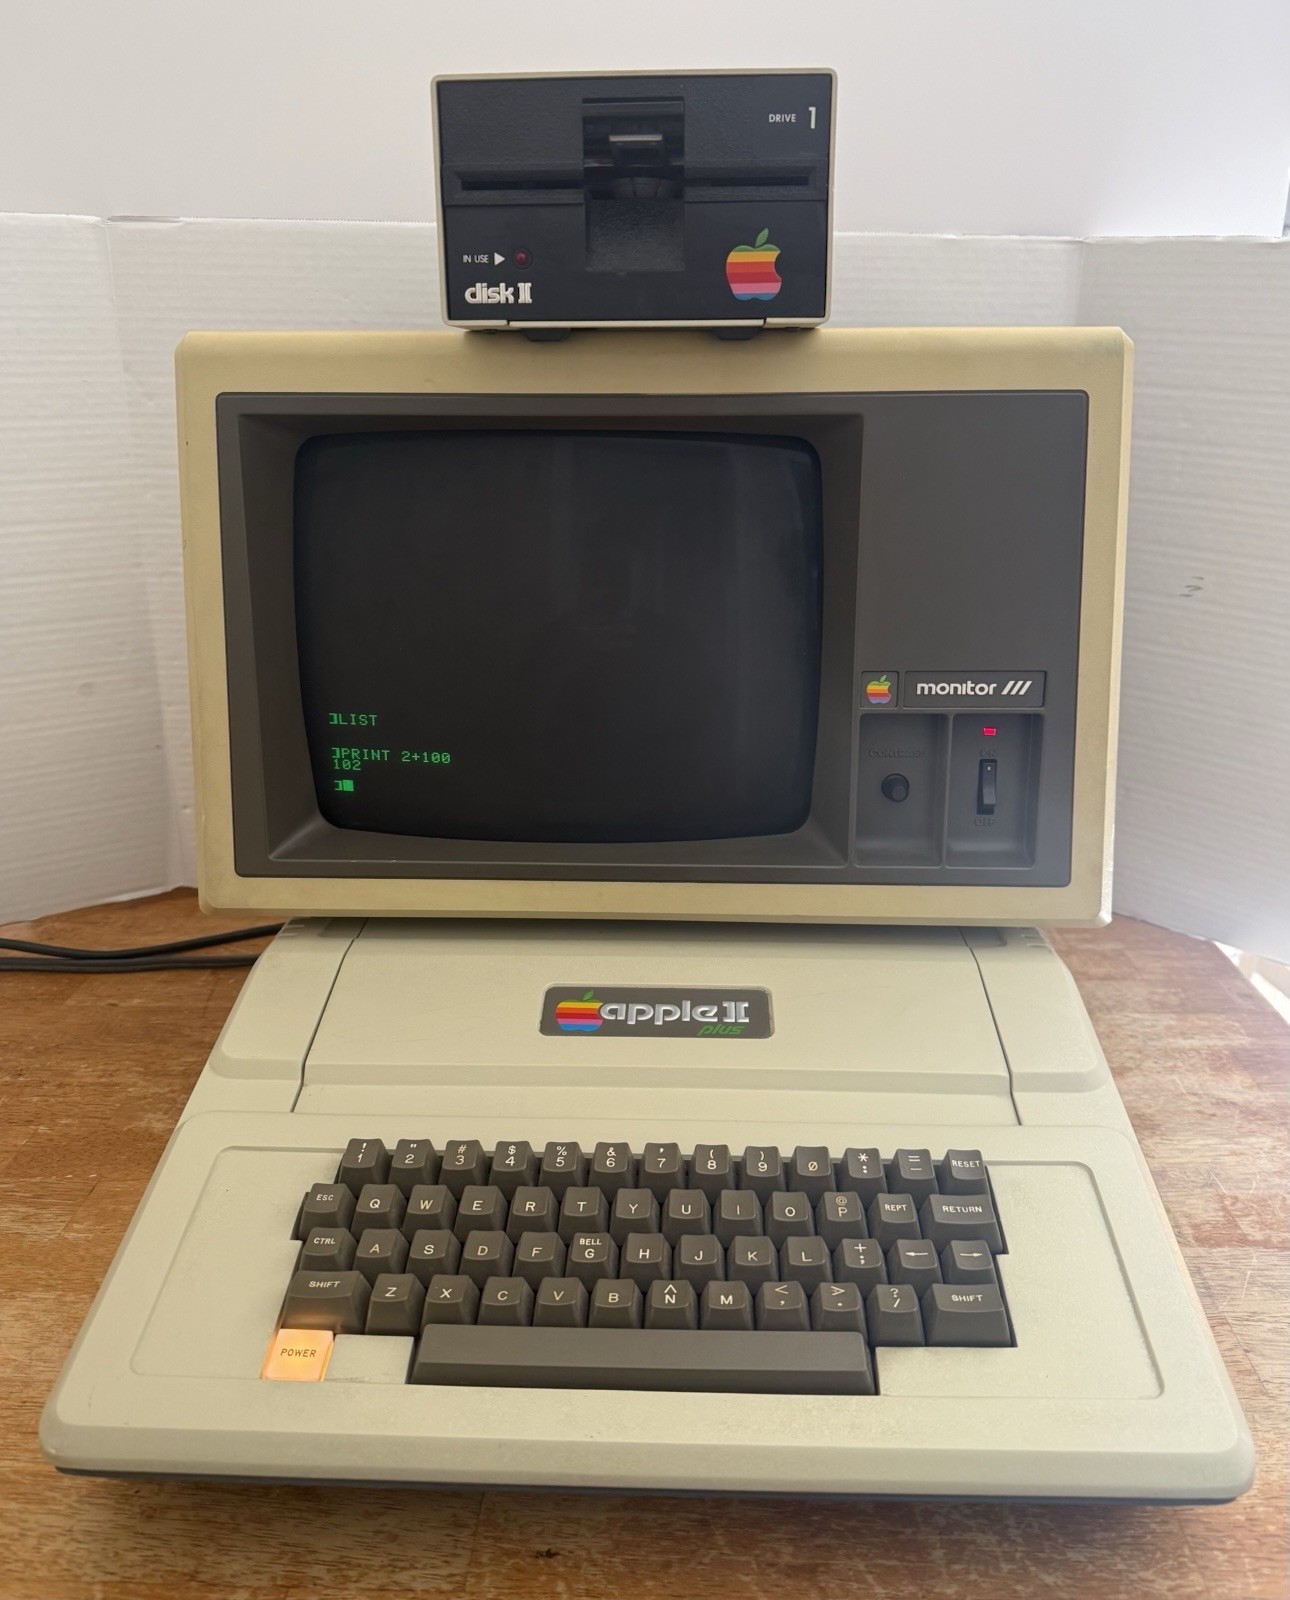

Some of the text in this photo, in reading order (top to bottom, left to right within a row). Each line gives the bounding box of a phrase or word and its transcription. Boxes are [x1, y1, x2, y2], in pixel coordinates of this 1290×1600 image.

[768, 106, 817, 130] DRIVE 1
[462, 254, 490, 264] IN USE
[464, 282, 514, 304] disk
[917, 681, 997, 695] monitor
[329, 713, 377, 726] ]LIST
[402, 751, 451, 763] 2+100
[333, 760, 361, 771] 102
[974, 818, 996, 826] OFF
[600, 1000, 718, 1025] apple
[697, 1023, 745, 1035] plus
[457, 1144, 468, 1154] #
[507, 1144, 517, 1155] $
[556, 1145, 568, 1156] %
[606, 1146, 617, 1157] &
[357, 1153, 363, 1163] 1
[404, 1153, 415, 1164] 2
[454, 1154, 465, 1165] 3
[505, 1155, 516, 1167] 4
[555, 1157, 565, 1167] 5
[606, 1157, 616, 1168] 6
[657, 1157, 666, 1168] 7
[951, 1159, 980, 1168] RESET
[707, 1159, 717, 1170] 8
[757, 1161, 768, 1172] 9
[316, 1193, 334, 1201] ESC
[835, 1195, 848, 1206] @
[369, 1198, 381, 1209] Q
[420, 1199, 434, 1210] W
[472, 1200, 484, 1211] E
[525, 1201, 536, 1212] R
[576, 1201, 587, 1212] T
[628, 1203, 639, 1214] Y
[884, 1203, 907, 1212] REPT
[942, 1205, 983, 1213] RETURN
[681, 1204, 692, 1215] U
[784, 1206, 796, 1217] O
[837, 1206, 848, 1218] P
[313, 1237, 336, 1245] CTRL
[579, 1237, 602, 1246] BELL
[369, 1243, 380, 1254] A
[423, 1244, 435, 1255] S
[477, 1245, 489, 1256] D
[531, 1247, 543, 1257] F
[584, 1248, 595, 1259] G
[639, 1248, 650, 1259] H
[853, 1243, 867, 1253] +
[694, 1250, 703, 1261] J
[747, 1251, 758, 1261] K
[801, 1251, 812, 1262] L
[308, 1280, 341, 1288] SHIFT
[384, 1286, 398, 1297] Z
[439, 1288, 453, 1299] X
[497, 1290, 509, 1301] C
[553, 1290, 565, 1301] V
[889, 1287, 899, 1298] ?
[608, 1292, 619, 1303] B
[664, 1294, 676, 1304] N
[720, 1294, 733, 1305] M
[951, 1294, 983, 1302] SHIFT
[280, 1348, 317, 1358] POWER
